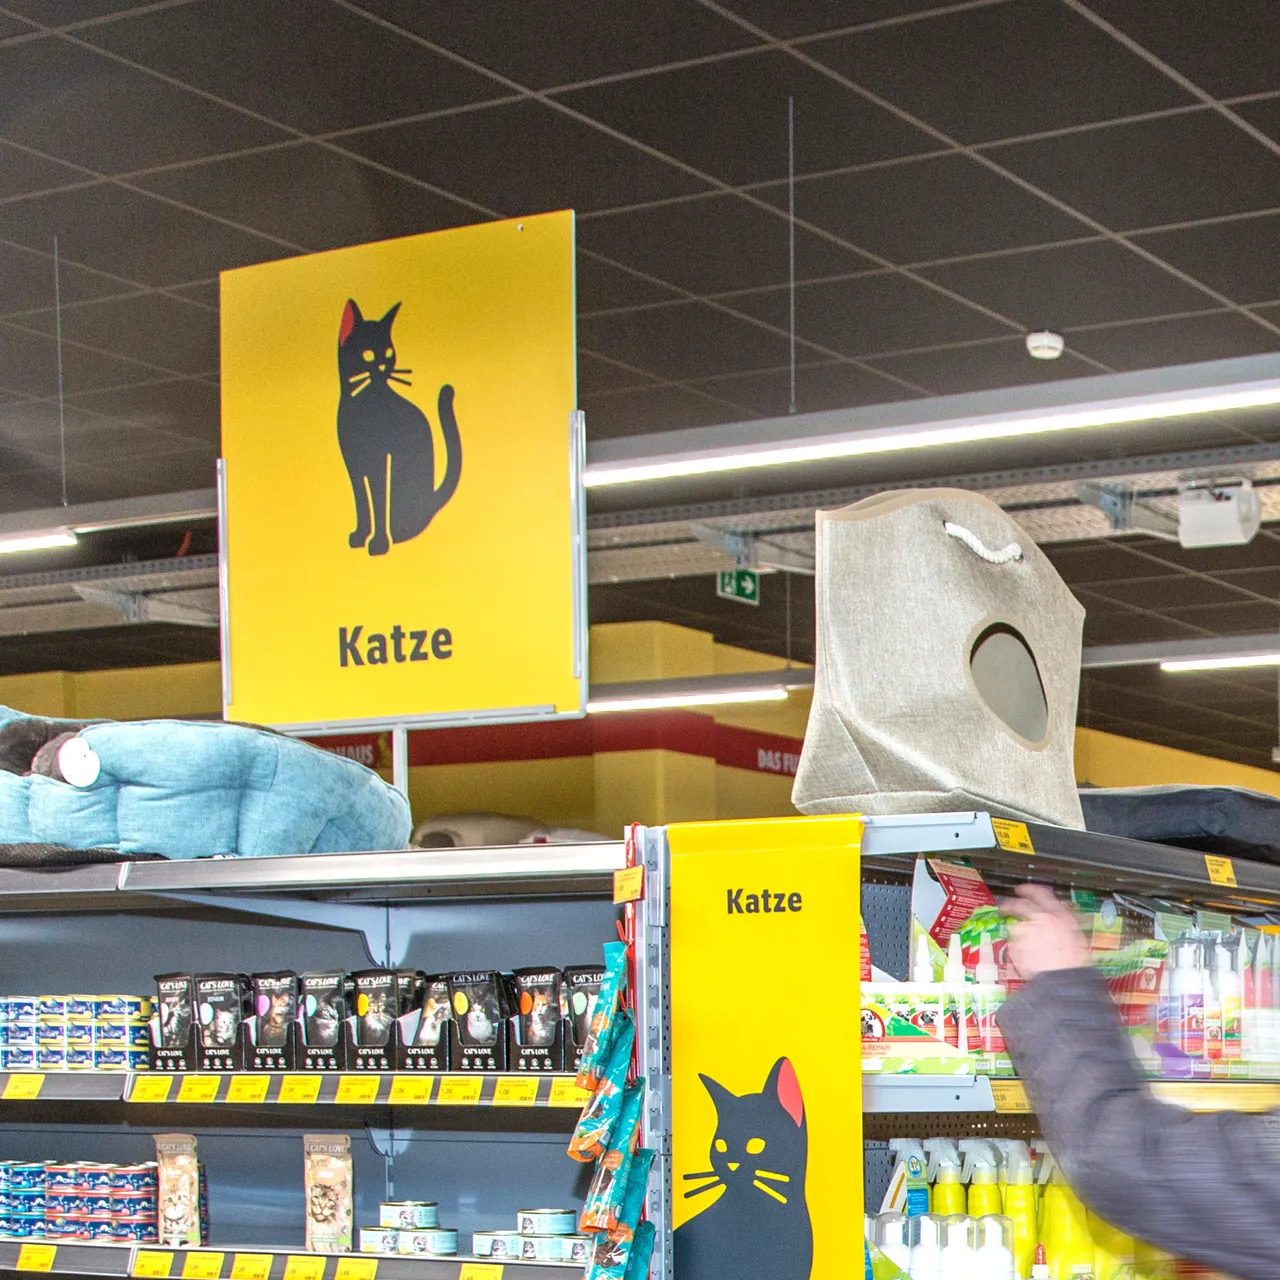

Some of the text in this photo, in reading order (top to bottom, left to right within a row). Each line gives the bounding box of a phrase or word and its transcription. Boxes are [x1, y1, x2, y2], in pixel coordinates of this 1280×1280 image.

[338, 624, 453, 668] Katze
[727, 888, 802, 914] Katze
[453, 974, 490, 983] CAT'S LOVE
[573, 974, 592, 983] CAT'S
